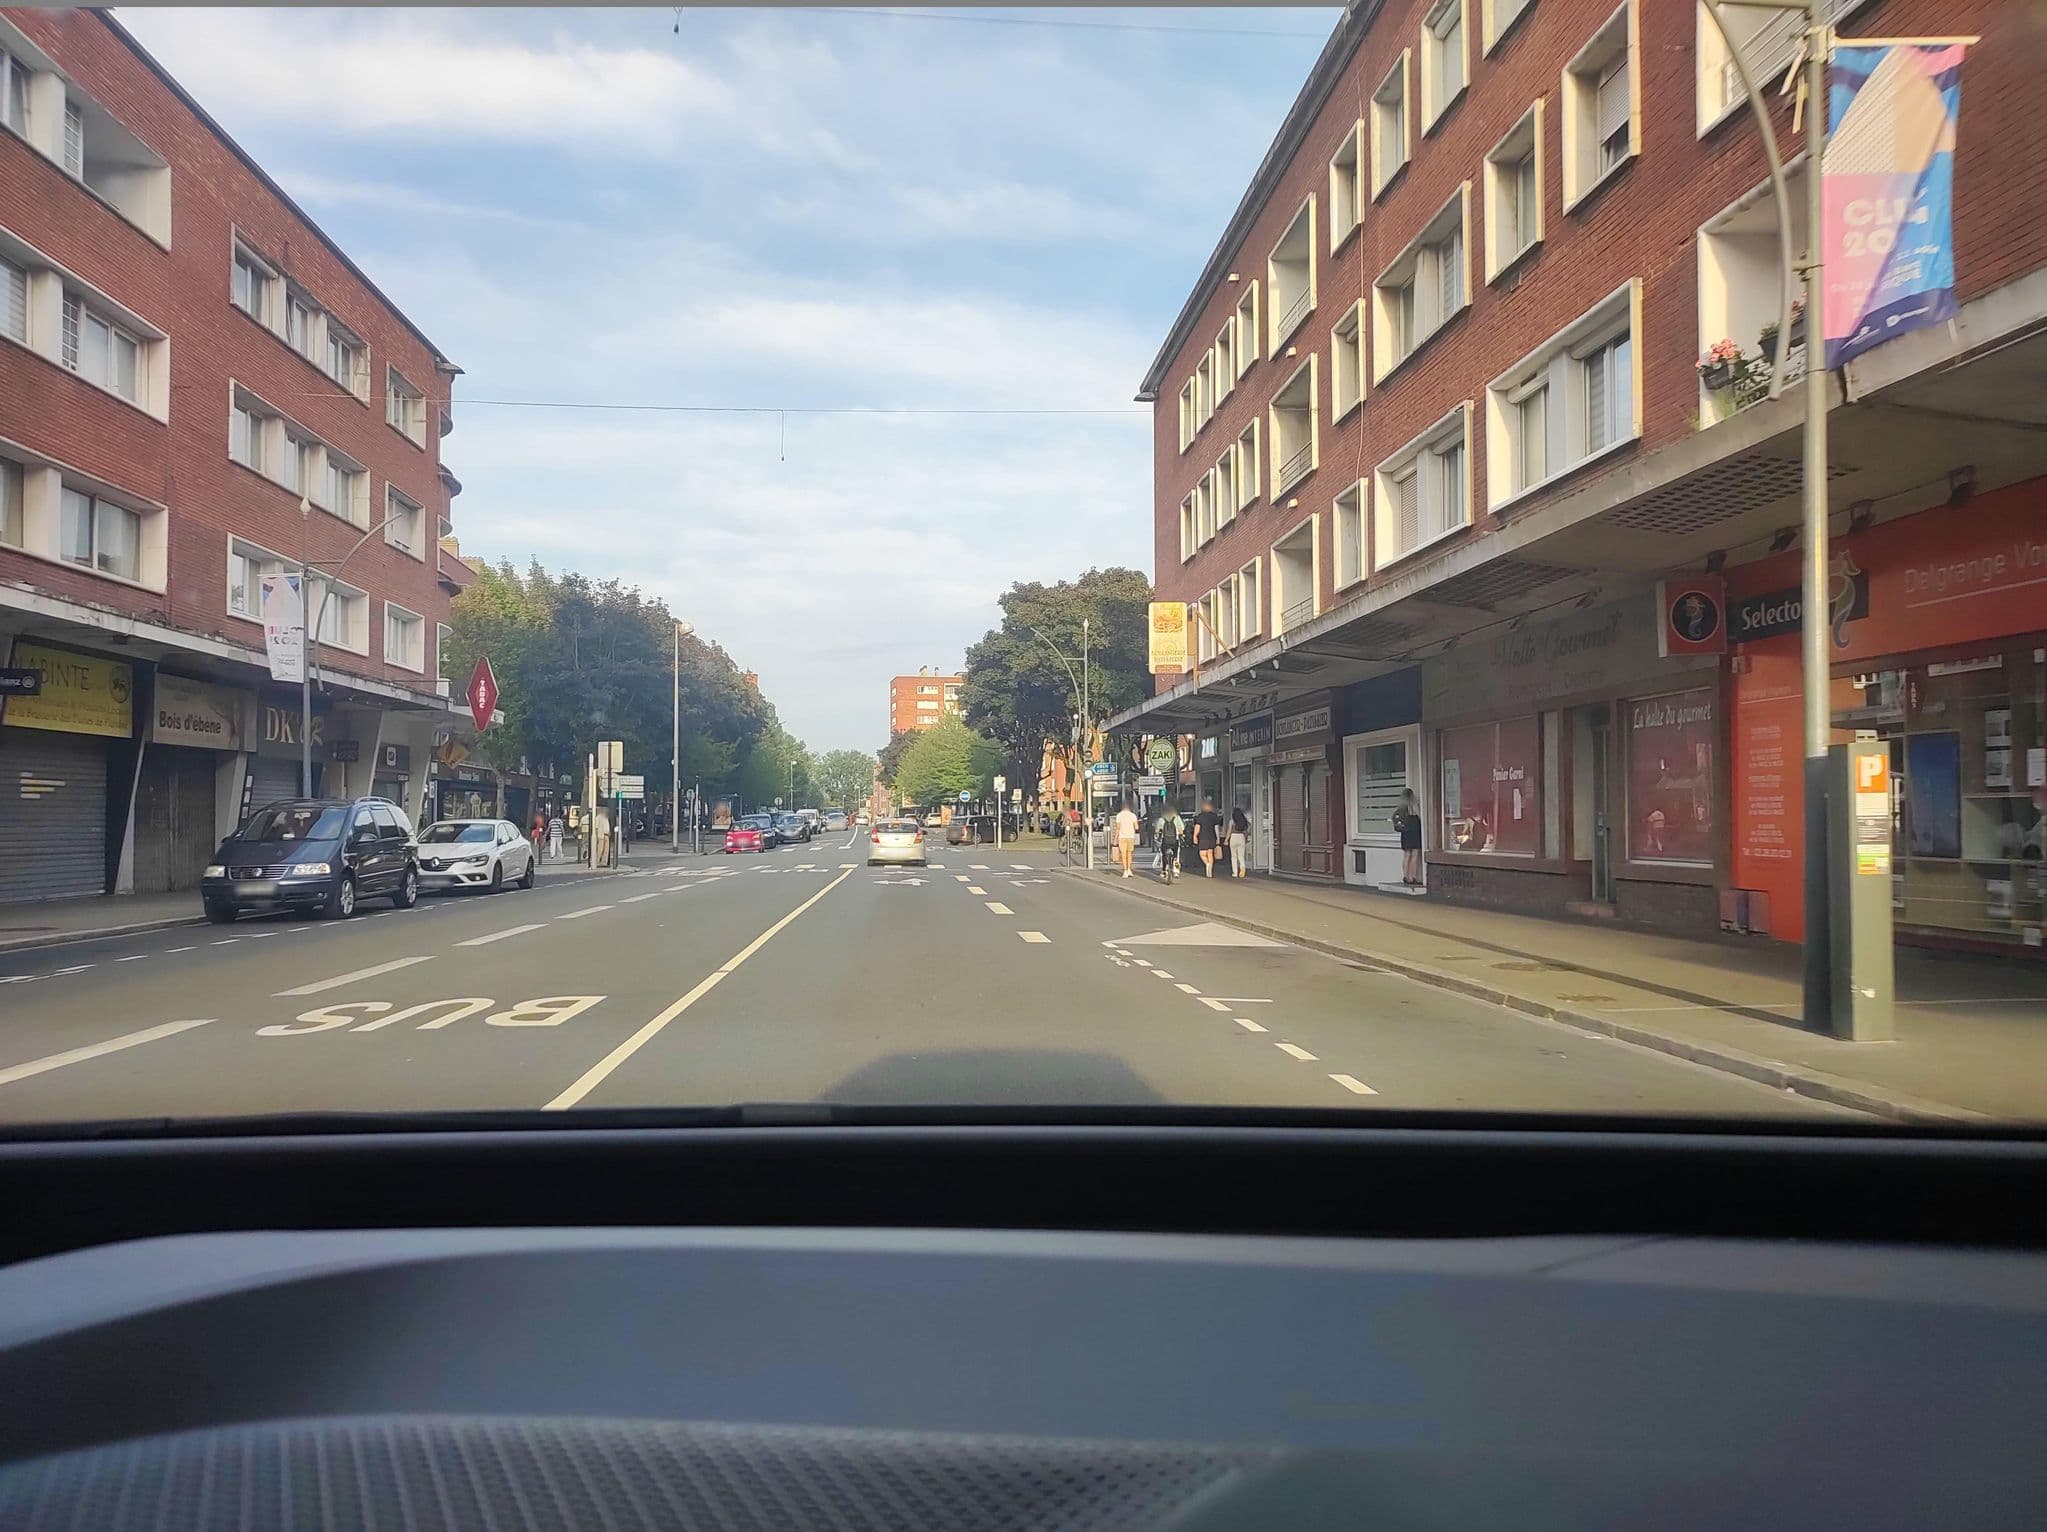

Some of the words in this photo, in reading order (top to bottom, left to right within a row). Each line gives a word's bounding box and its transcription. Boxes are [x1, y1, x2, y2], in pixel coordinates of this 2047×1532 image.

[1741, 600, 1801, 631] Selecto
[479, 679, 487, 709] TABAC
[159, 710, 182, 730] Bois
[1859, 755, 1883, 788] P
[255, 995, 608, 1037] BUS
